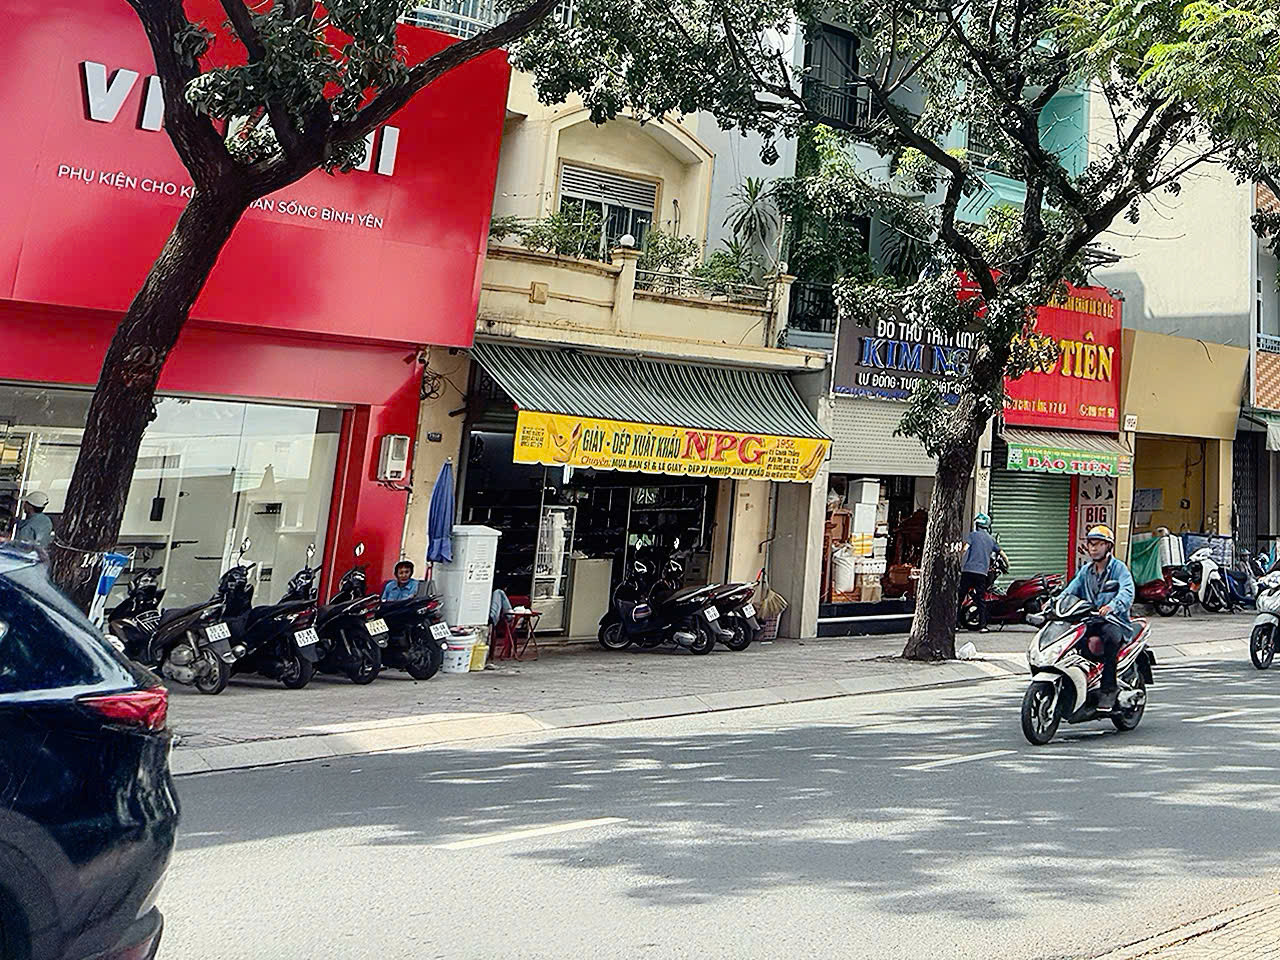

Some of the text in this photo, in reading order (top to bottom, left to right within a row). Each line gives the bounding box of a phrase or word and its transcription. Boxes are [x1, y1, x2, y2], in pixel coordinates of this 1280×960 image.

[58, 163, 95, 185] PHỤ
[98, 171, 138, 190] KIỆN
[140, 178, 177, 196] CHO
[278, 199, 318, 219] SỐNG
[320, 207, 355, 225] BÌNH
[357, 213, 384, 230] YÊN
[861, 336, 925, 373] KIM
[1059, 331, 1115, 381] TIÊN
[612, 428, 631, 455] DÉP
[681, 431, 767, 464] NPG
[612, 458, 627, 468] MUA
[1085, 507, 1108, 524] BIG
